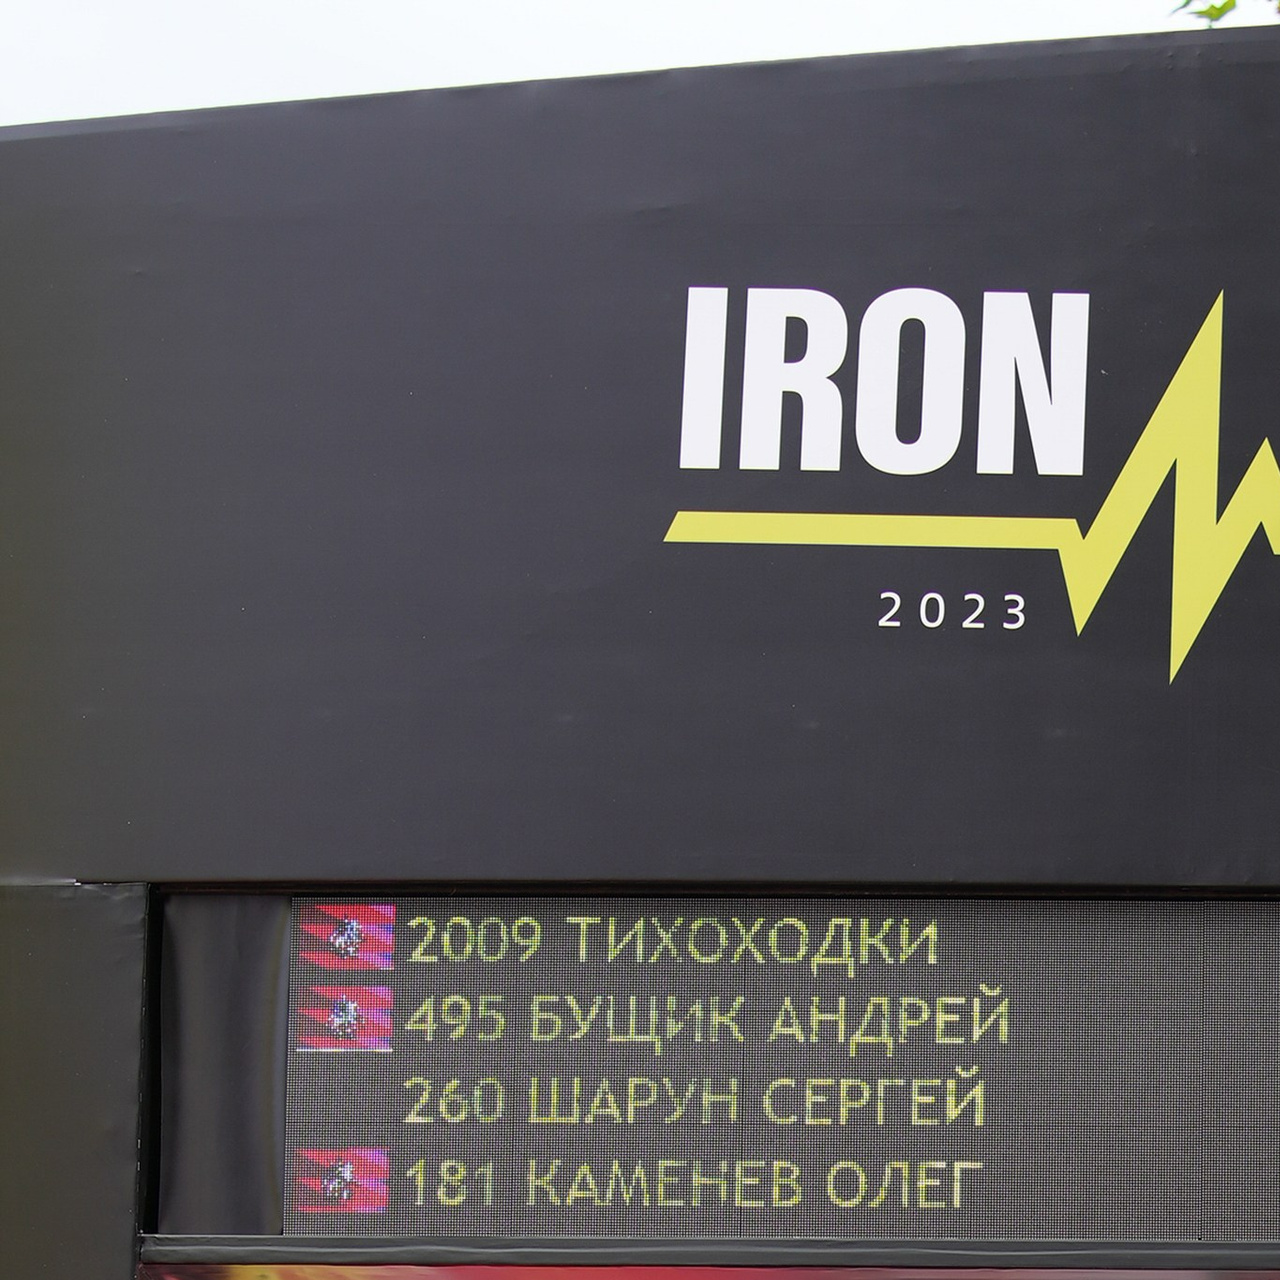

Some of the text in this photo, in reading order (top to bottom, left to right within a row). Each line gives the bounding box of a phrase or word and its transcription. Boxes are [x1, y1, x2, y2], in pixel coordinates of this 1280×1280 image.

[679, 286, 1090, 476] IRON
[878, 591, 1028, 630] 2023
[406, 916, 938, 977] 2009 ТИХОХОДКИ
[404, 984, 1009, 1057] 495 БУЩИК АНДРЕЙ
[404, 1066, 985, 1126] 260 ШАРУН СЕРГЕЙ
[406, 1160, 983, 1208] 181 КАМЕНЕВ ОЛЕГ
